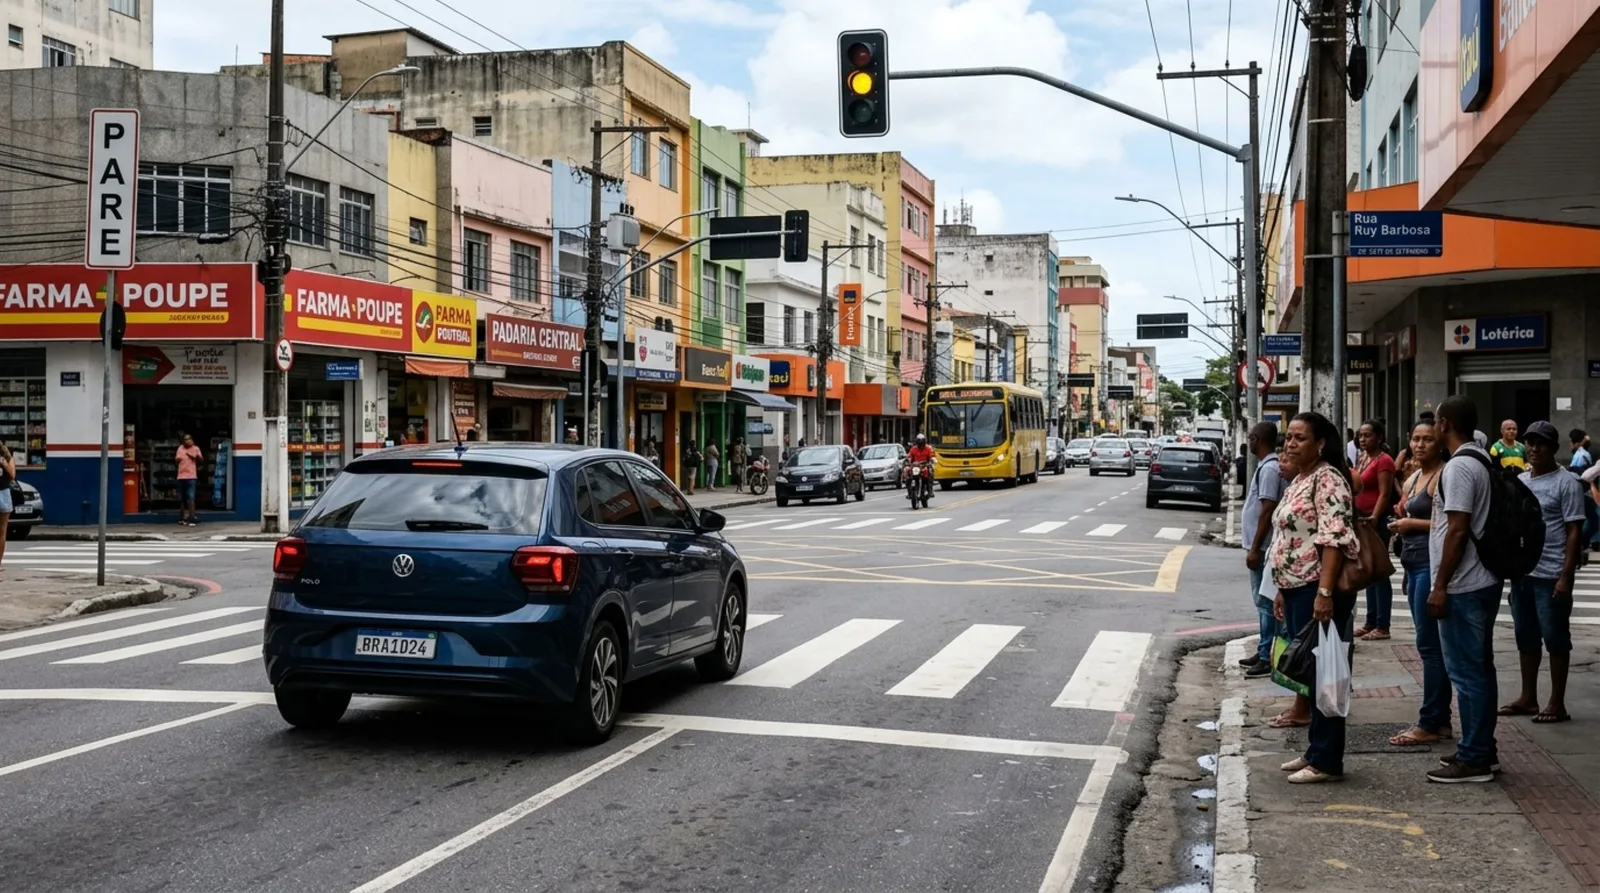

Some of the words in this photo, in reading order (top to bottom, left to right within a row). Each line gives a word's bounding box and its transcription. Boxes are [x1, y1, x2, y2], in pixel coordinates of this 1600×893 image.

[100, 122, 125, 256] PARE
[1354, 213, 1378, 224] Rua
[1354, 225, 1378, 238] Ruy
[1381, 225, 1431, 236] Barbosa
[123, 283, 228, 308] POUPE
[297, 288, 351, 318] FARMA
[357, 297, 403, 324] POUPE
[492, 320, 537, 346] PADARIA
[539, 328, 582, 351] CENTRAL
[1481, 326, 1534, 340] Lotérica
[362, 637, 427, 655] BRA1D24
